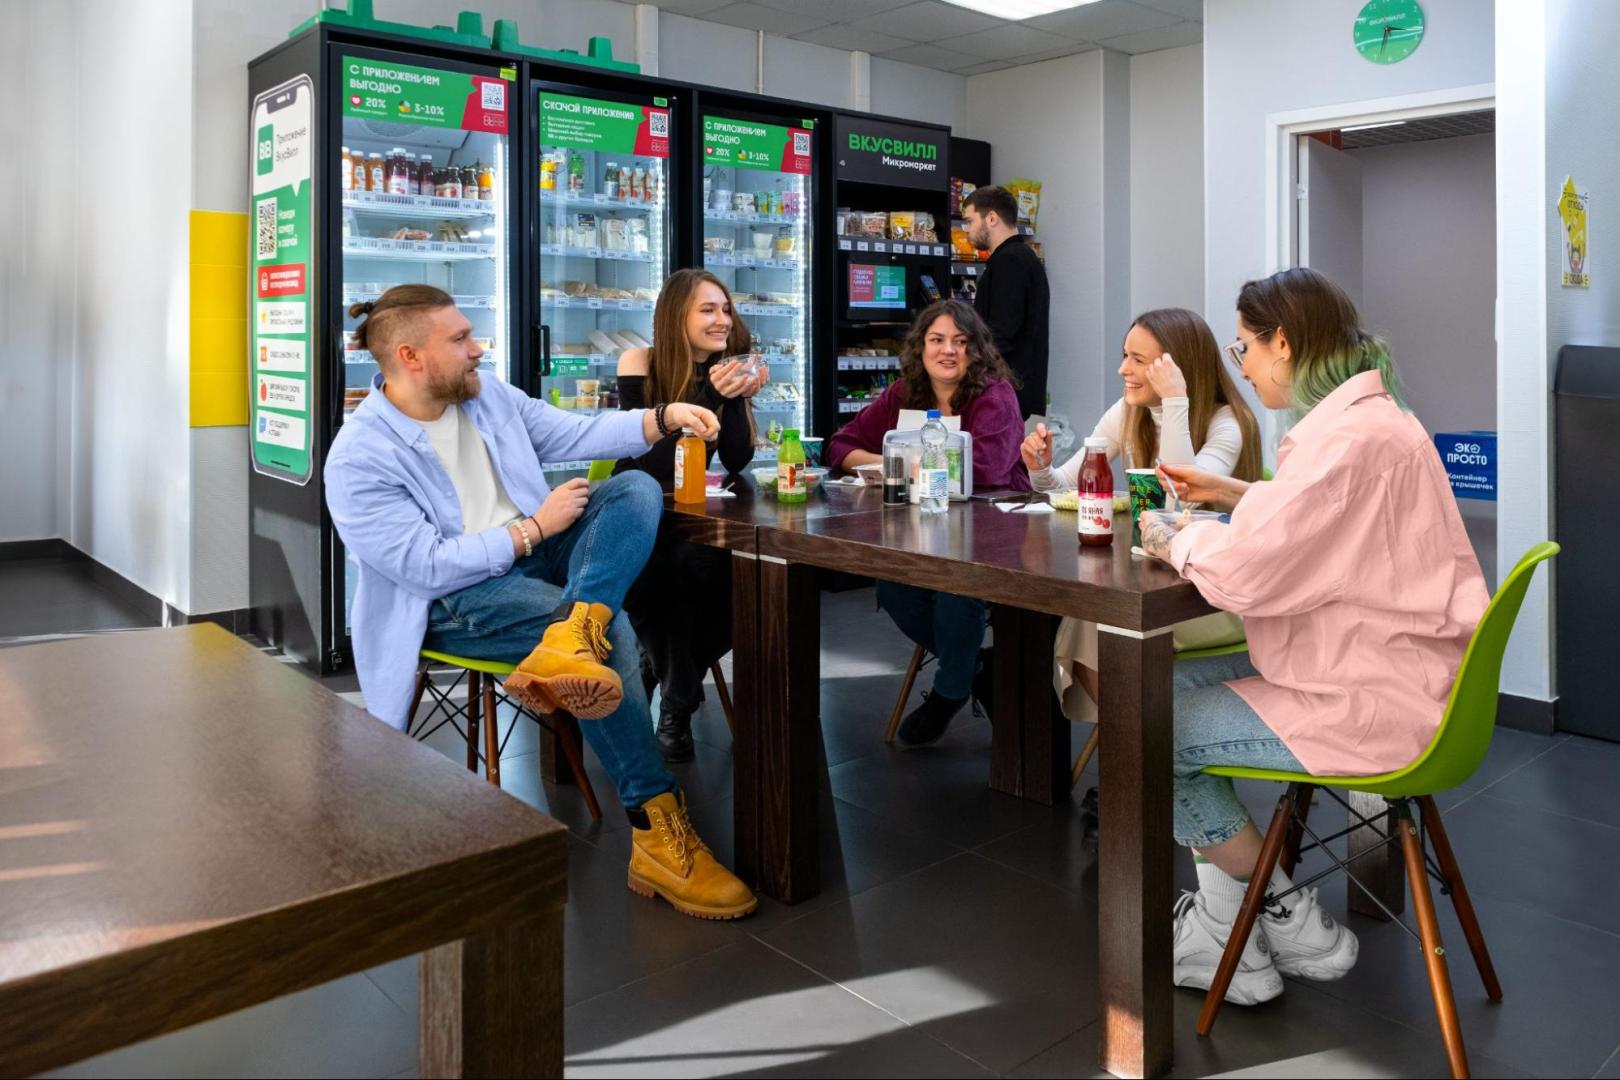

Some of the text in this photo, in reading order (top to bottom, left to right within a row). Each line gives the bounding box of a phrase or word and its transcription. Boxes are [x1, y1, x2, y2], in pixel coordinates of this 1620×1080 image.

[349, 64, 439, 86] С ПРИЛОЖЕНИЕМ
[349, 78, 402, 95] ВЫГОДНО
[366, 97, 387, 109] 20%
[543, 101, 634, 120] СКАЧАЙ ПРИЛОЖЕНИЕ
[705, 121, 767, 137] С ПРИЛОЖЕНИЕМ
[705, 133, 741, 145] ВЫГОДНО
[849, 134, 937, 160] ВКУСВИЛЛ
[882, 157, 936, 170] Микромаркет
[1447, 453, 1487, 465] ПРОСТО
